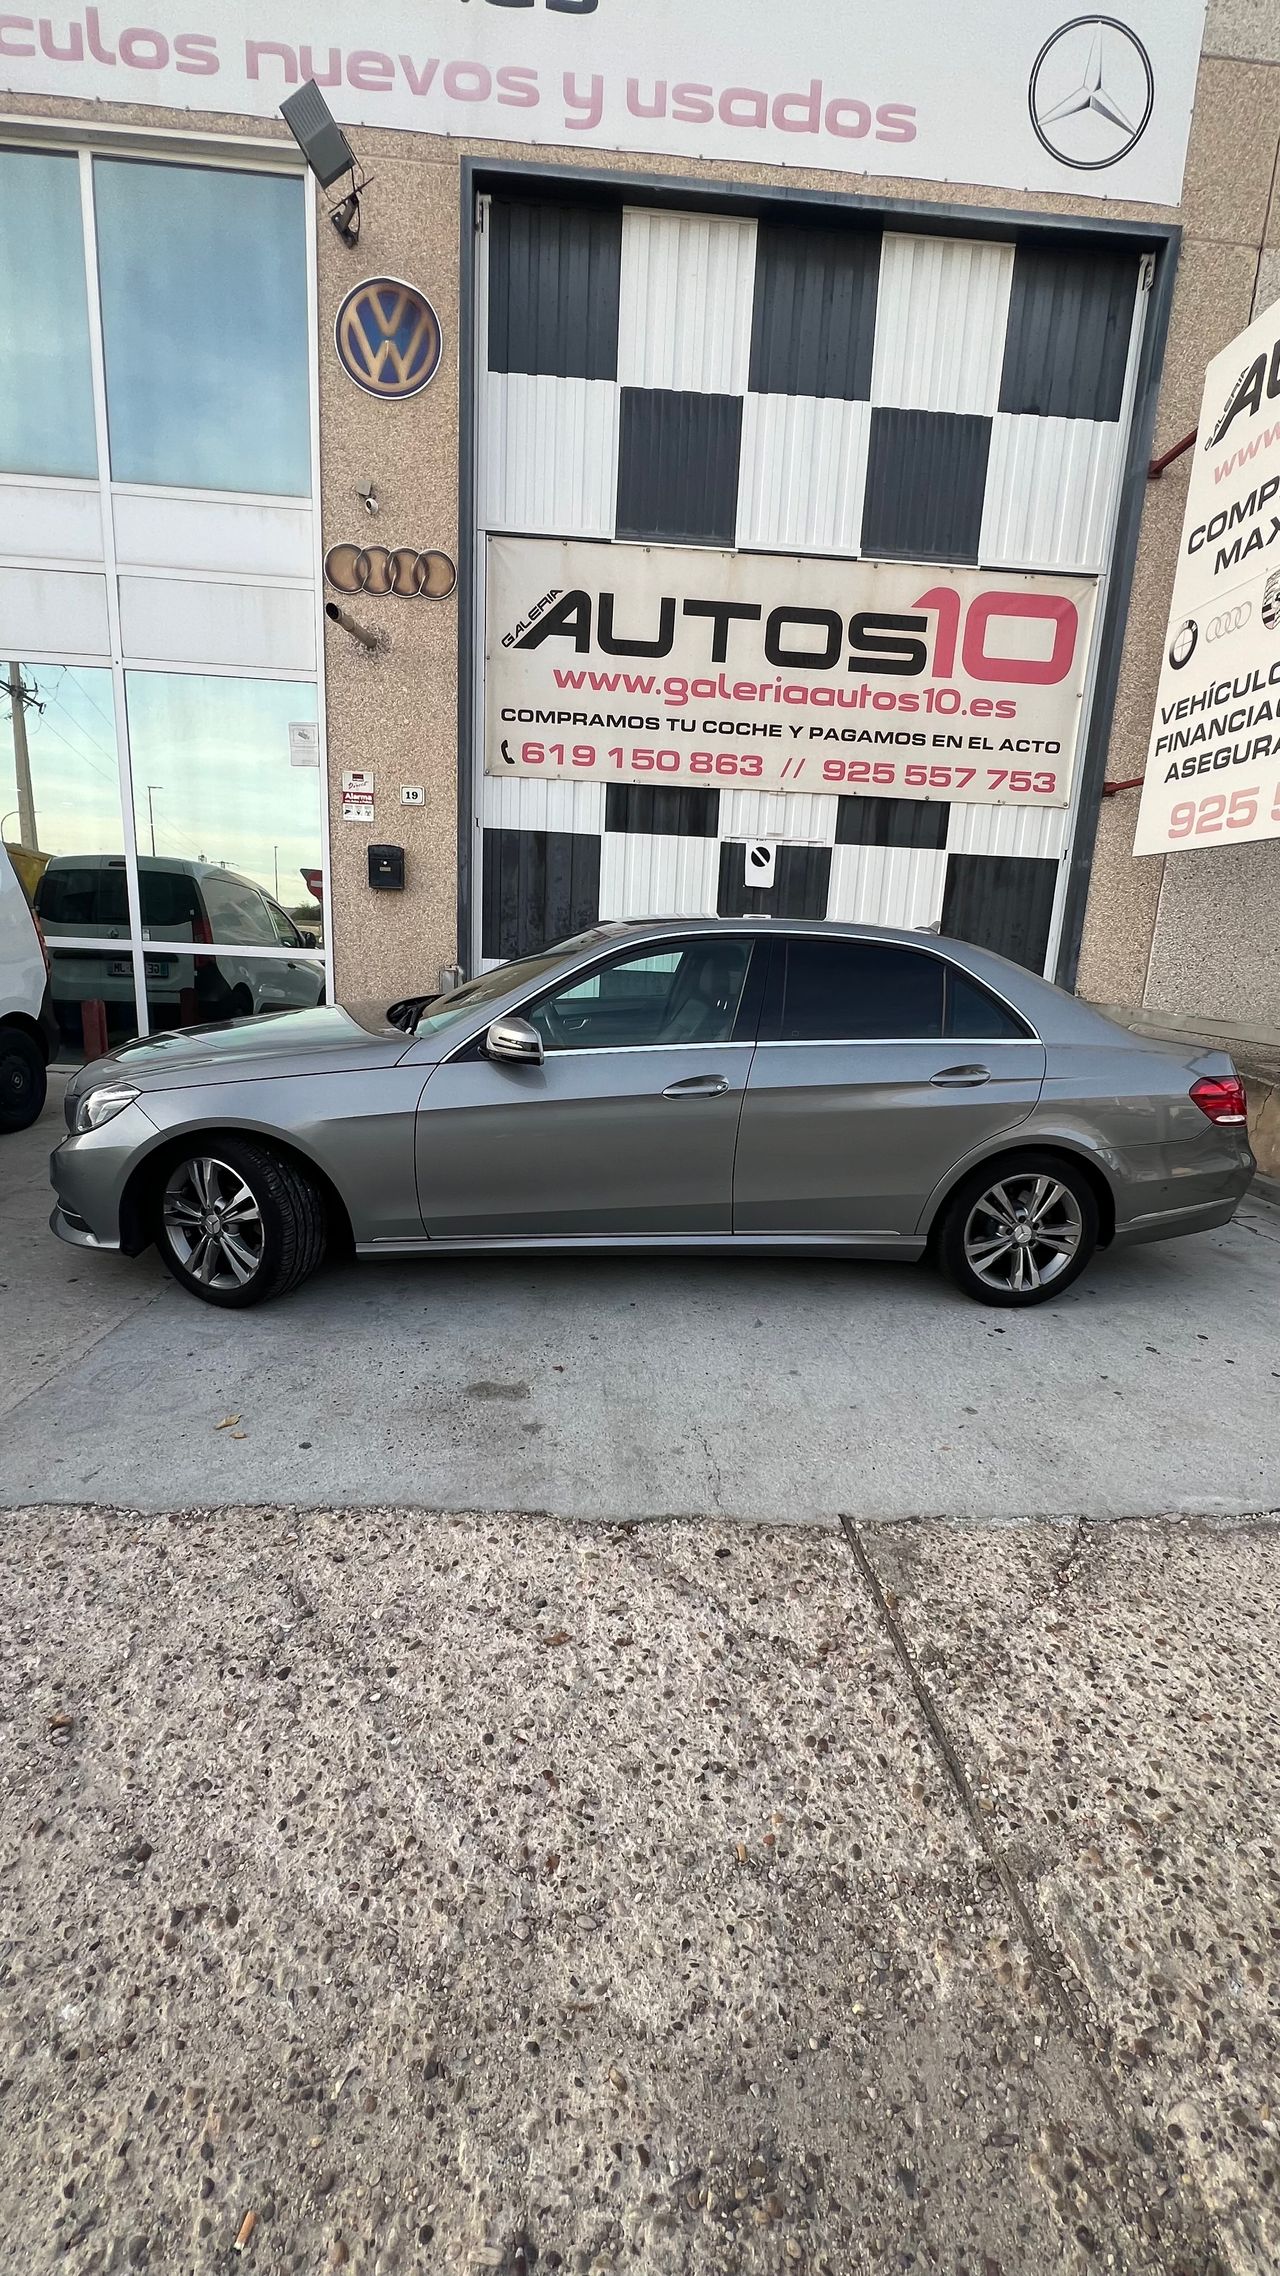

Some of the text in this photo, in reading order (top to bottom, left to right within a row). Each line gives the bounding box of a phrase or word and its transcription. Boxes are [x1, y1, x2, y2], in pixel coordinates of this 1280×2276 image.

[245, 38, 541, 108] nuevos
[562, 71, 603, 130] y
[626, 78, 917, 143] usados
[501, 589, 564, 648] GALERIA
[553, 668, 1016, 719] www.galeriaautos10.es
[501, 708, 1061, 754] COMPRAMOS TU COCHE Y PAGAMOS EN EL ACTO
[521, 741, 596, 767] 619
[608, 747, 680, 772] 150
[690, 752, 763, 777] 863
[822, 760, 895, 784] 925
[904, 765, 977, 788] 557
[986, 769, 1056, 793] 753
[405, 791, 418, 799] 19
[1168, 786, 1260, 839] 925
